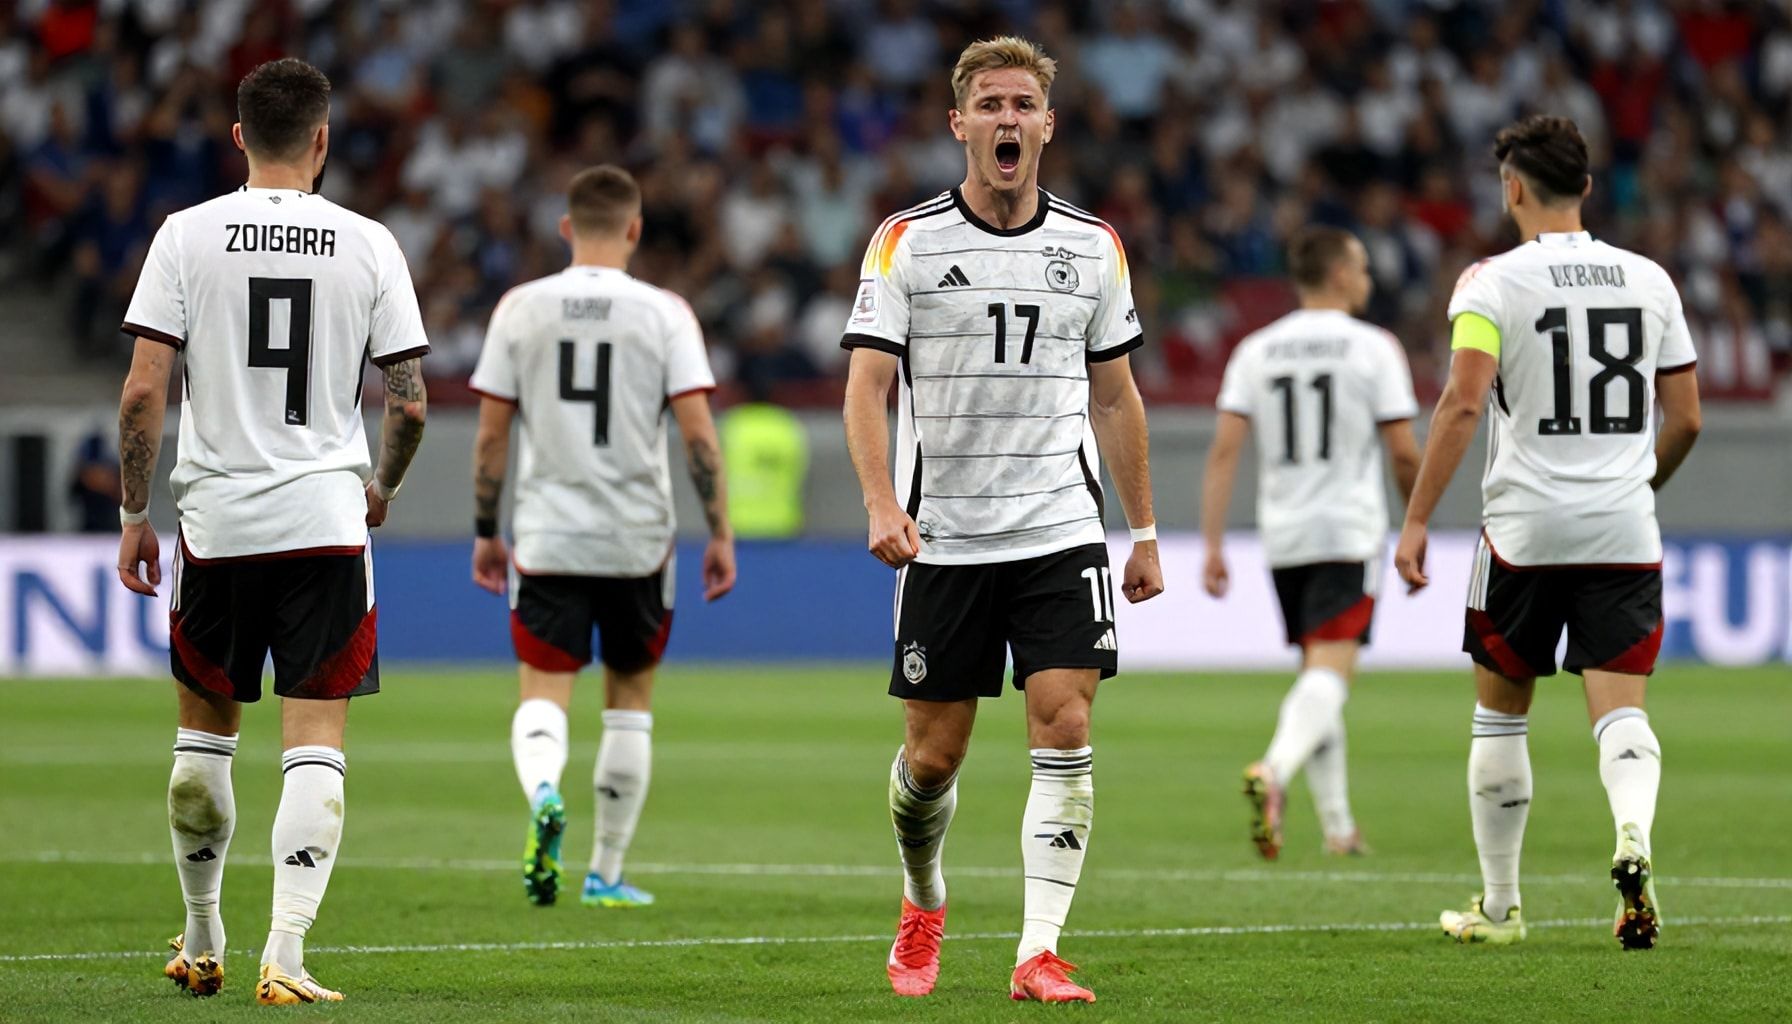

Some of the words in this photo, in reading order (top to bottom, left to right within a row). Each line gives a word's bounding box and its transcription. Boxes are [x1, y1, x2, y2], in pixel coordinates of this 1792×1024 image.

[247, 277, 313, 425] 9
[987, 302, 1041, 364] 17
[1535, 306, 1645, 435] 18
[558, 340, 611, 445] 4
[1270, 373, 1334, 463] 11
